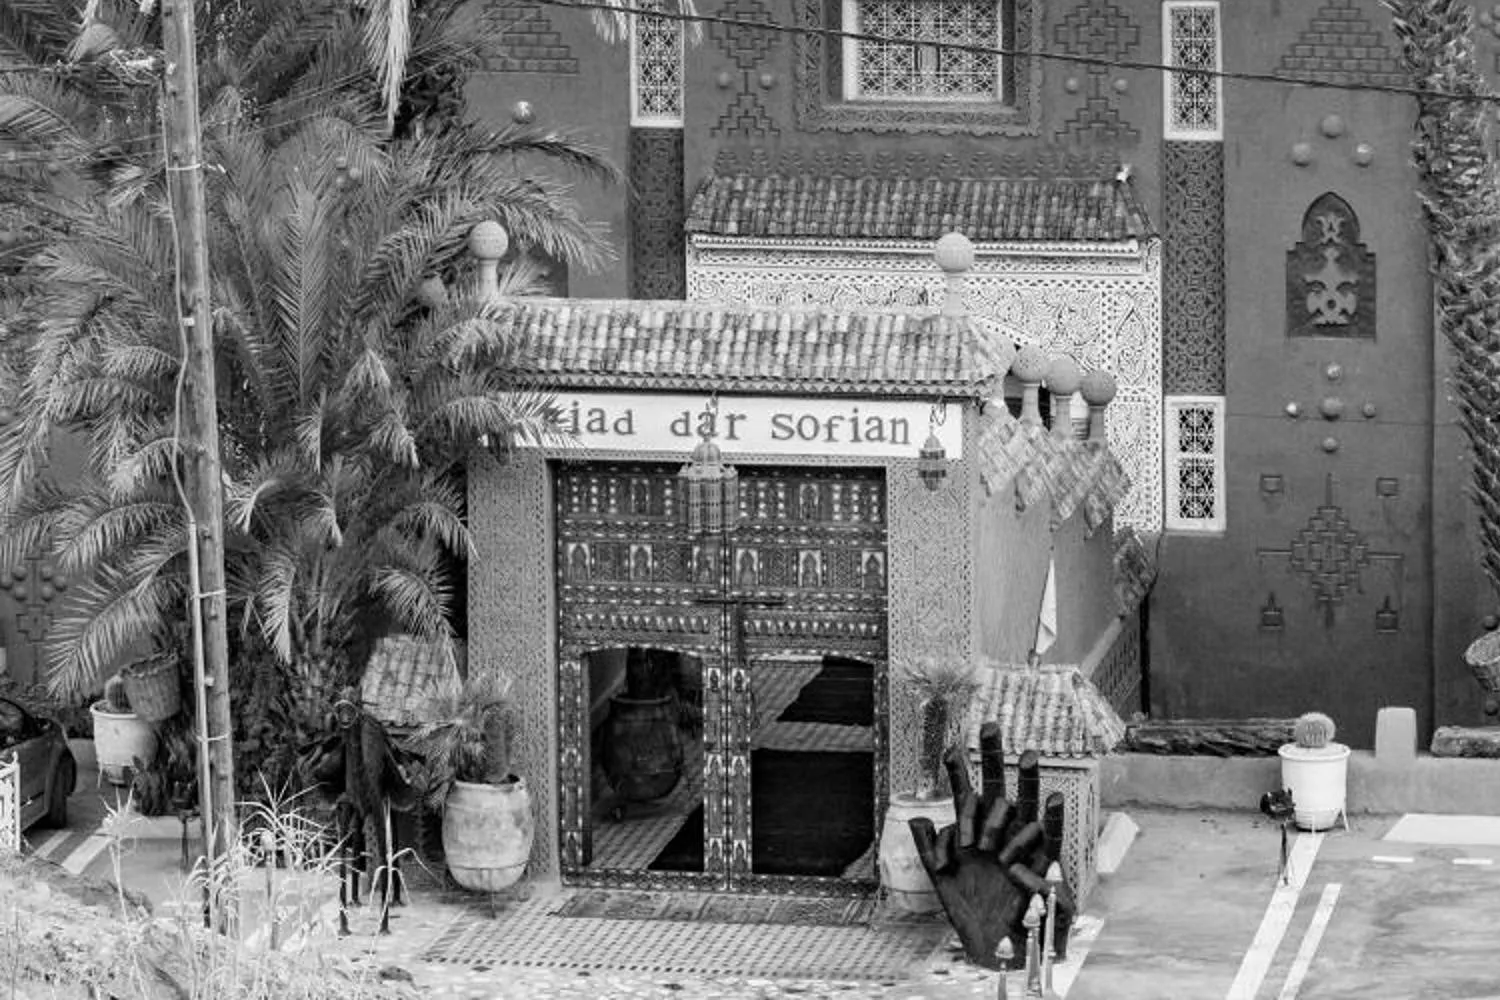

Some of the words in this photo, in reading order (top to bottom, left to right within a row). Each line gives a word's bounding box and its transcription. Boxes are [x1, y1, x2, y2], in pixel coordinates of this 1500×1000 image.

[547, 400, 635, 436] iad
[669, 410, 747, 441] dar
[771, 407, 910, 445] sofian
